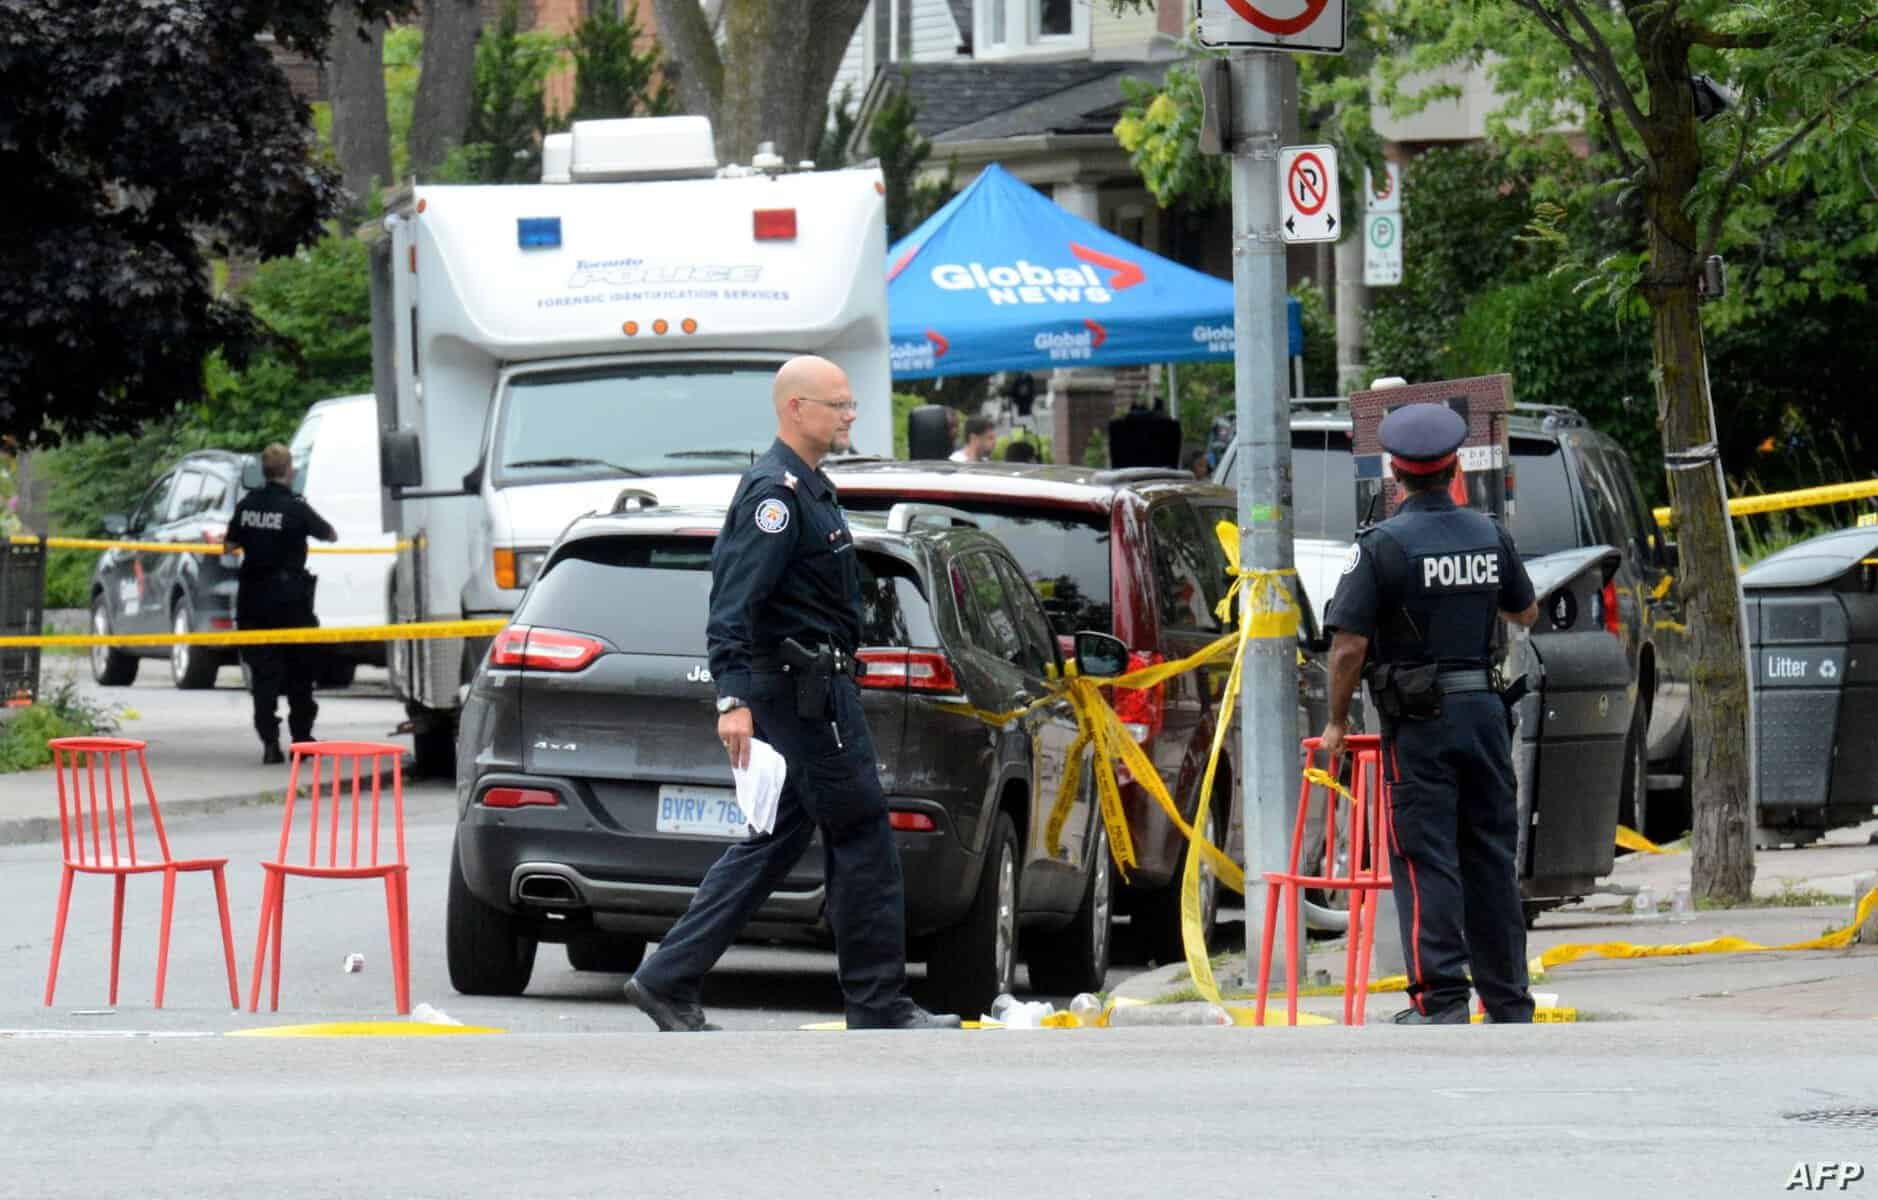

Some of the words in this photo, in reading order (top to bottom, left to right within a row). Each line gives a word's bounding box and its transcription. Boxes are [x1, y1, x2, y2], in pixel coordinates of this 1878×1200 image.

[575, 257, 644, 271] Toronto
[567, 264, 763, 289] POLICE
[931, 260, 1101, 291] Global
[537, 293, 606, 309] FORENSIC
[609, 289, 719, 302] IDENTIFICATION
[723, 288, 790, 301] SERVICES
[987, 286, 1112, 305] NEWS
[1034, 330, 1090, 350] Global
[1191, 325, 1235, 342] Glob
[889, 341, 933, 358] lobal
[1050, 349, 1091, 361] NEWS
[1208, 341, 1237, 353] NEW
[892, 358, 934, 371] NEWS
[241, 509, 283, 530] POLICE
[1423, 553, 1500, 588] POLICE
[687, 665, 713, 683] Je
[1767, 656, 1808, 678] Litter
[662, 797, 706, 823] BVRV
